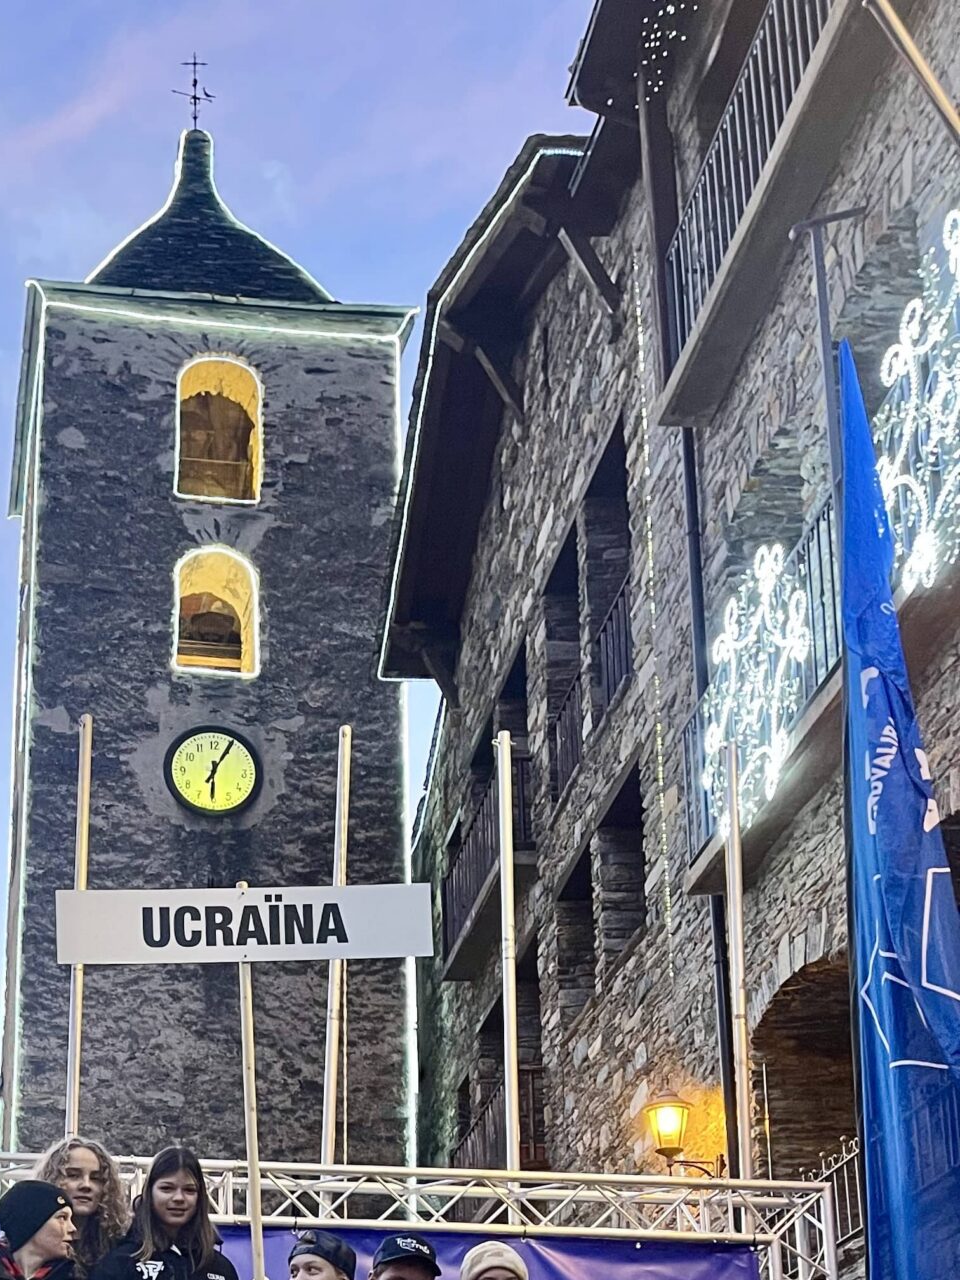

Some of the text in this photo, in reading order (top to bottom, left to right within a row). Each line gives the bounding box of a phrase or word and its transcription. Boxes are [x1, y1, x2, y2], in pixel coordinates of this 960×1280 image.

[197, 744, 203, 752] 11
[210, 741, 219, 750] 12
[186, 753, 195, 762] 10
[180, 766, 186, 776] 9
[241, 769, 248, 779] 3
[185, 780, 191, 789] 8
[236, 783, 242, 792] 4
[196, 790, 202, 799] 7
[226, 792, 232, 801] 5
[142, 894, 349, 948] UCRAÏNA
